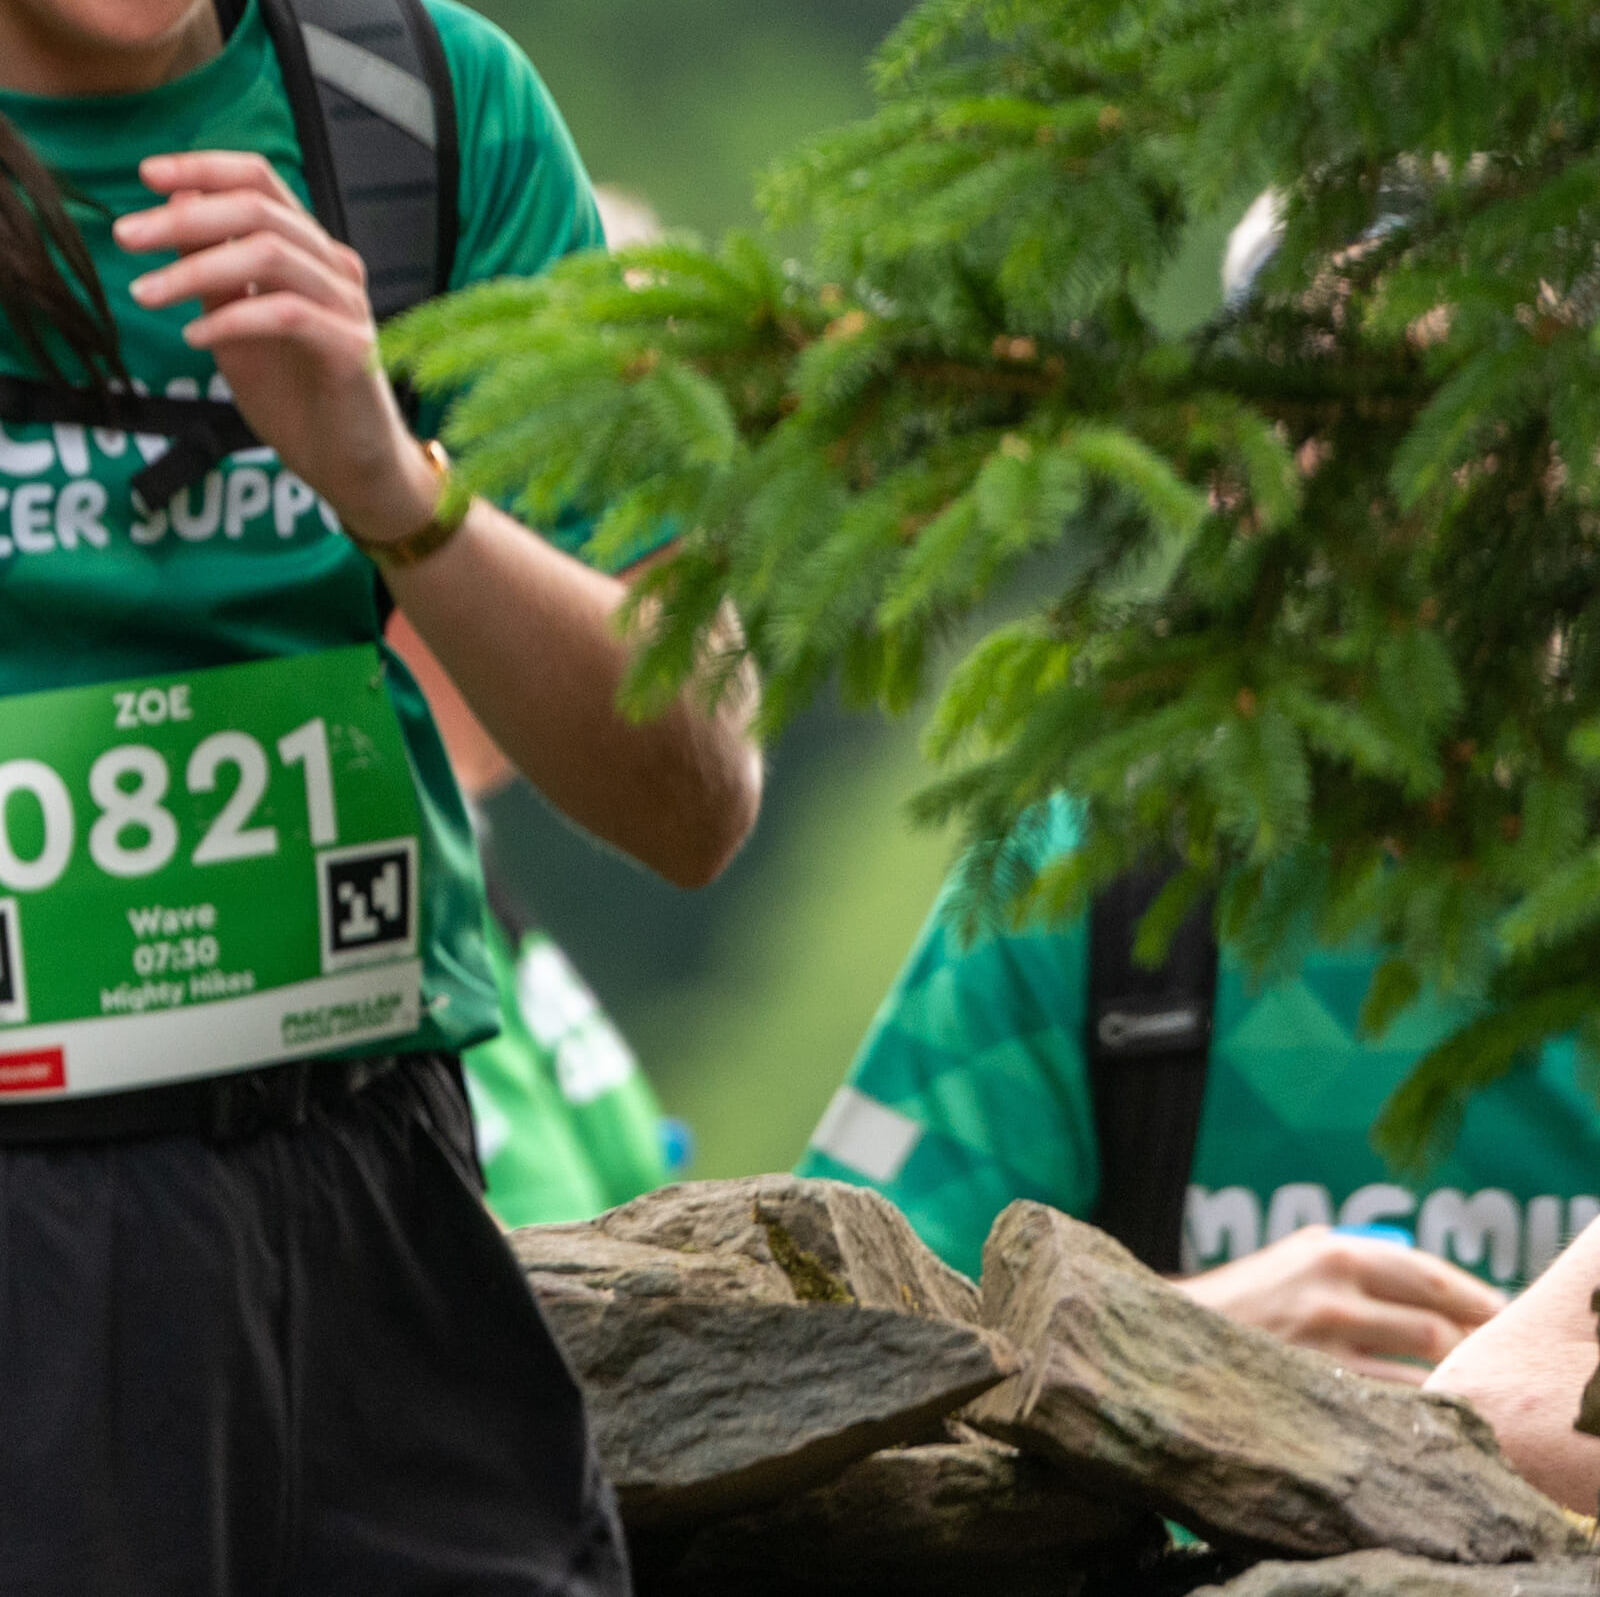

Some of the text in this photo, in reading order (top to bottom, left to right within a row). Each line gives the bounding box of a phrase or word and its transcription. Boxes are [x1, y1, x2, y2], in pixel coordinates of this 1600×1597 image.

[113, 684, 193, 729] ZOE
[127, 903, 217, 939] Wave
[133, 935, 220, 976] 07:30
[100, 967, 257, 1013] Mighty Hikes
